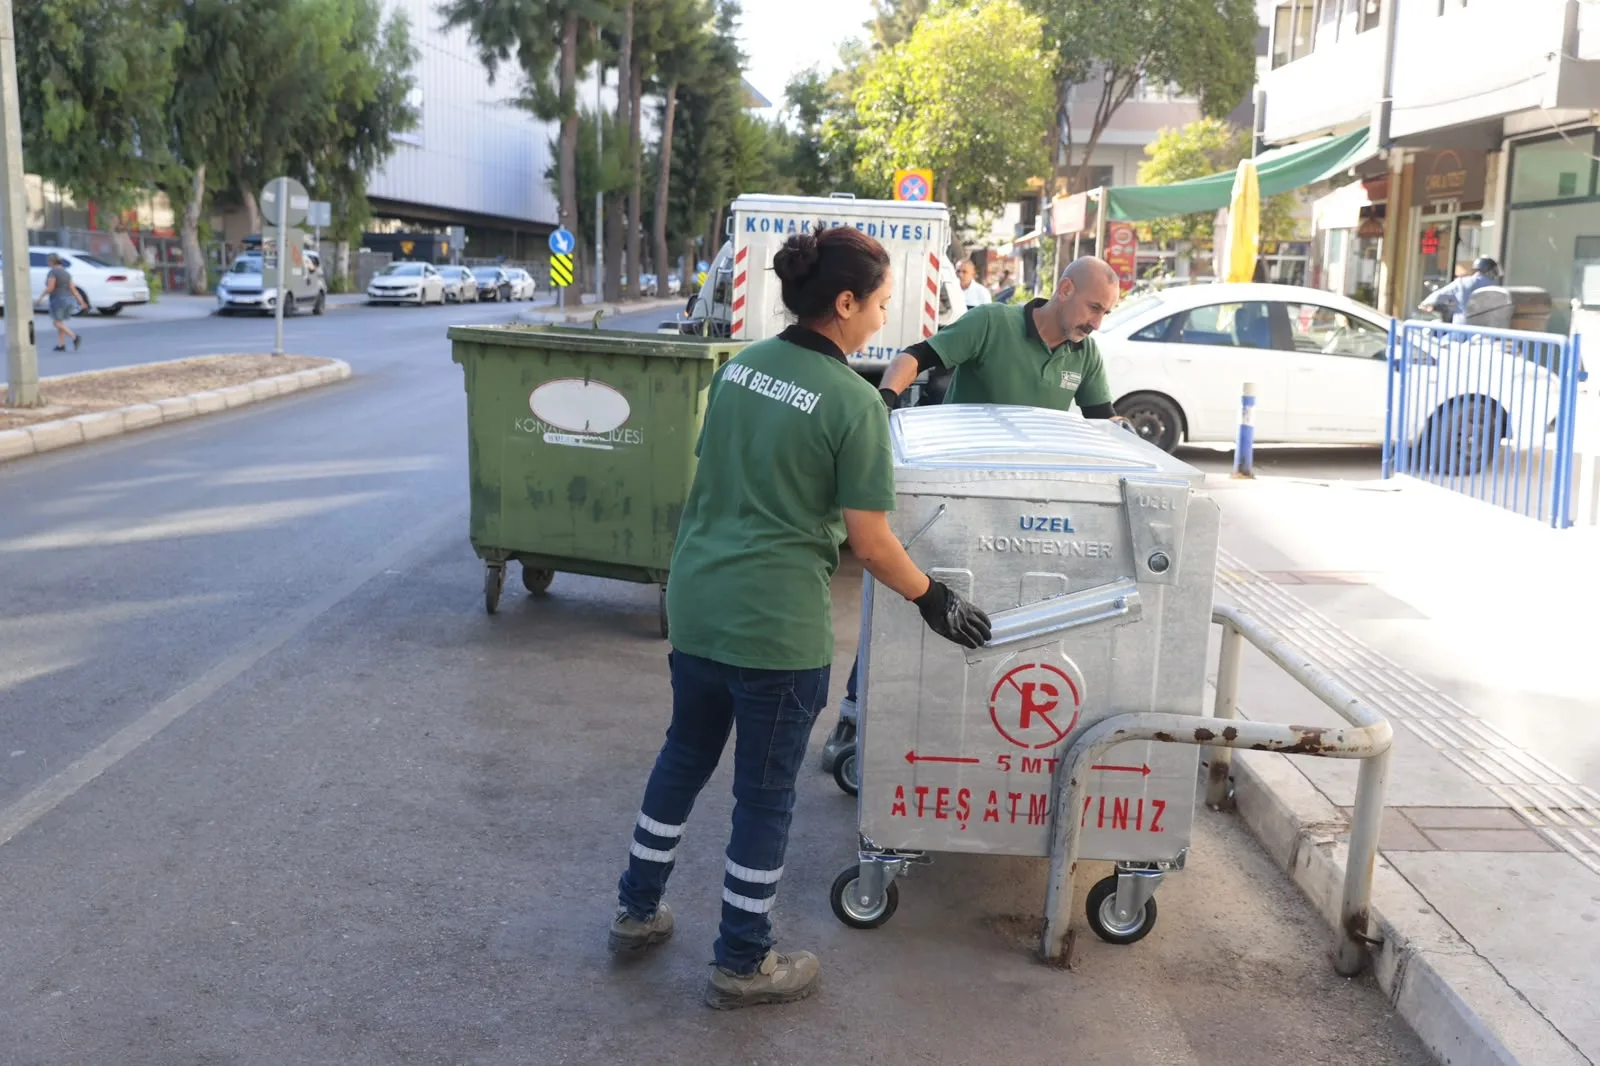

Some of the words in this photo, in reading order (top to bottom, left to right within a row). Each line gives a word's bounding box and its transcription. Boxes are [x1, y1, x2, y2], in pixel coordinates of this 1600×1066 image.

[746, 216, 810, 234] KONAK
[748, 370, 822, 415] BELEDİYESİ
[1019, 514, 1075, 534] UZEL
[977, 534, 1114, 560] KONTEYNER
[997, 755, 1012, 773] 5
[891, 785, 972, 831] ATEŞ
